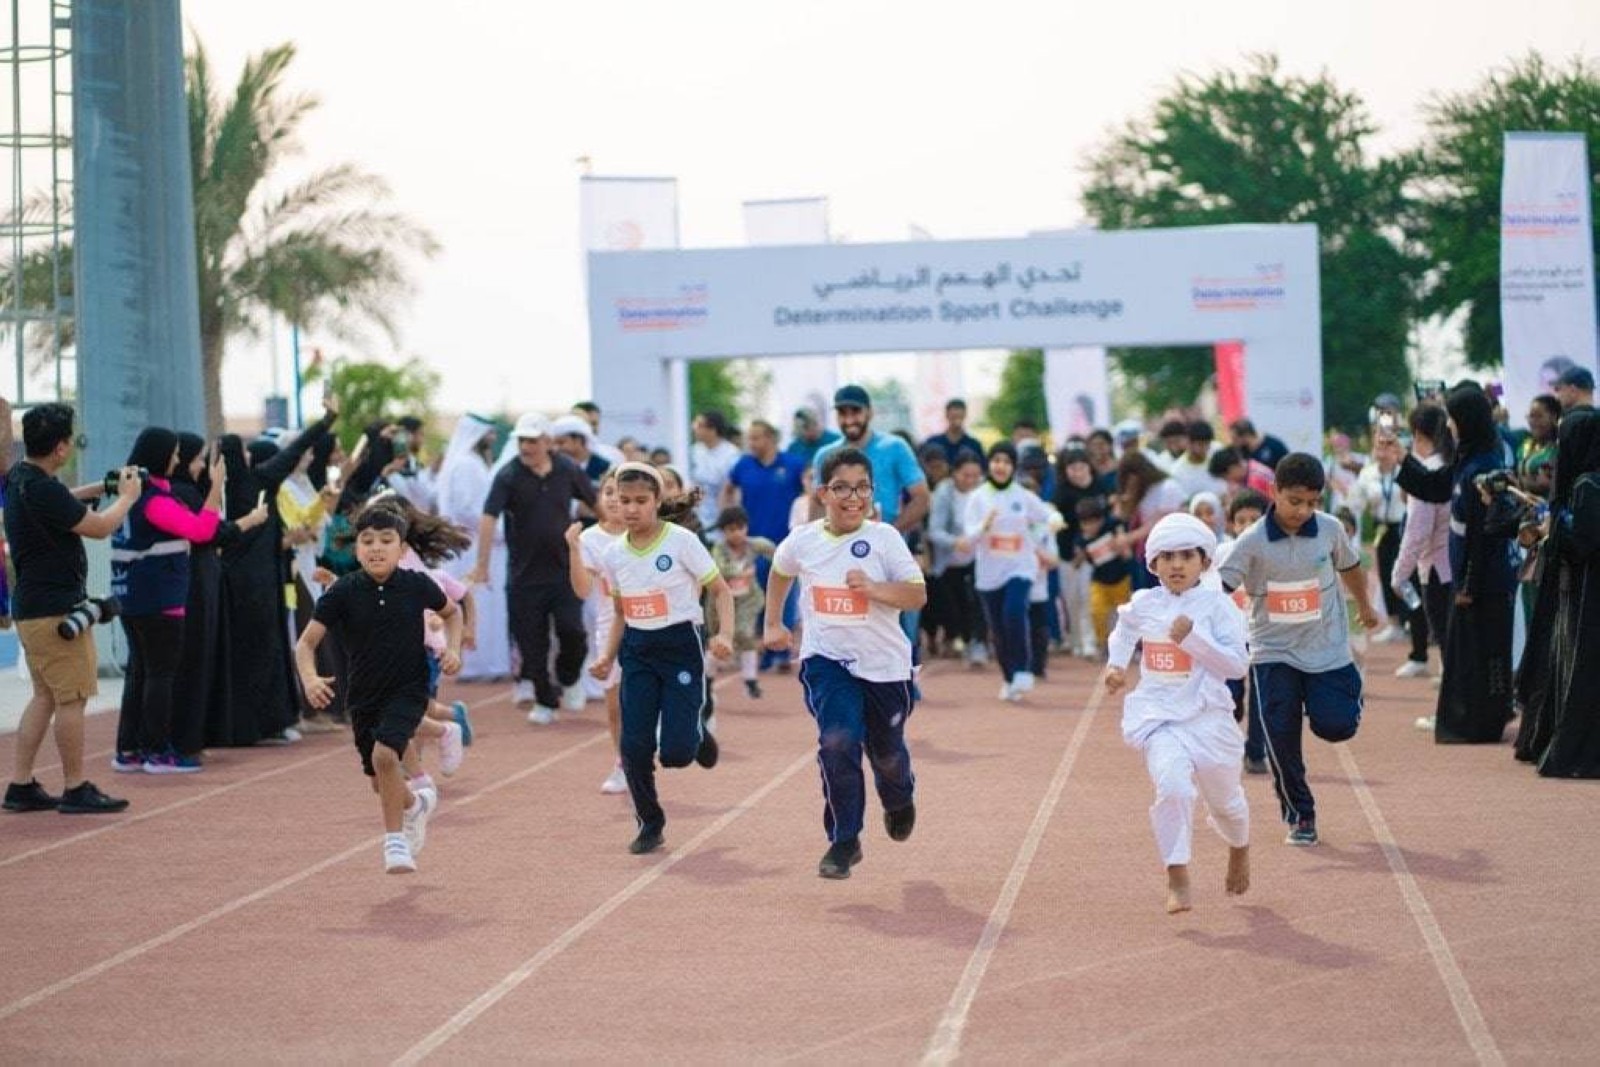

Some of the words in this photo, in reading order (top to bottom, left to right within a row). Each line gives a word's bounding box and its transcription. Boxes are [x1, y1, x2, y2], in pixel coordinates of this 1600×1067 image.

[812, 264, 931, 300] الرياضي
[935, 261, 1010, 296] الهمم
[1016, 261, 1082, 291] تحدي
[774, 305, 932, 326] Determination
[938, 300, 1000, 324] Sport
[1008, 297, 1123, 322] Challenge
[825, 597, 853, 612] 176
[1280, 598, 1308, 612] 193
[1149, 652, 1175, 669] 155
